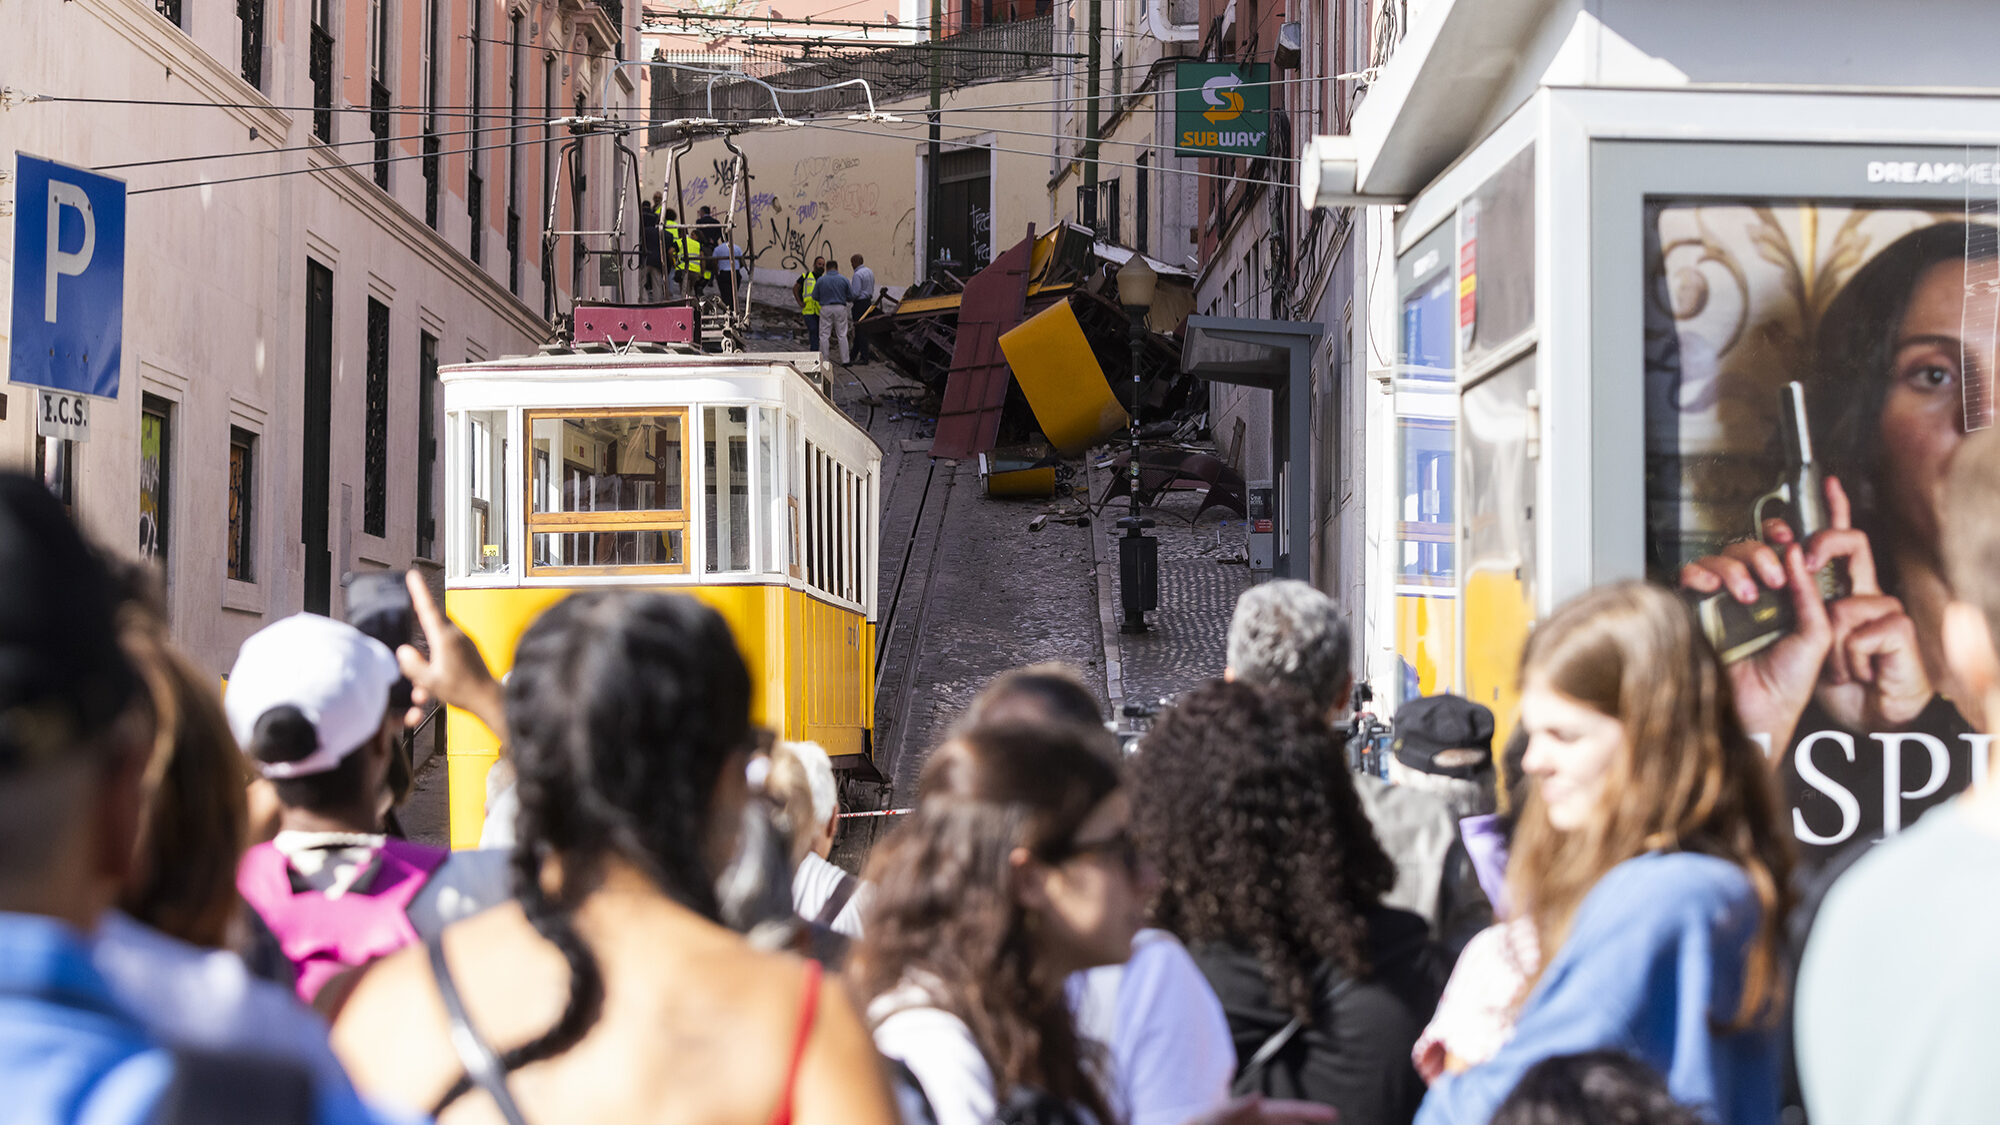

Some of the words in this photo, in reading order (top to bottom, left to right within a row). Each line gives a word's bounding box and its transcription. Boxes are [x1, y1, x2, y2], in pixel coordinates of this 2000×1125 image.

[1180, 131, 1266, 147] SUBWAY
[45, 178, 96, 324] P
[44, 394, 87, 427] I.C.S.
